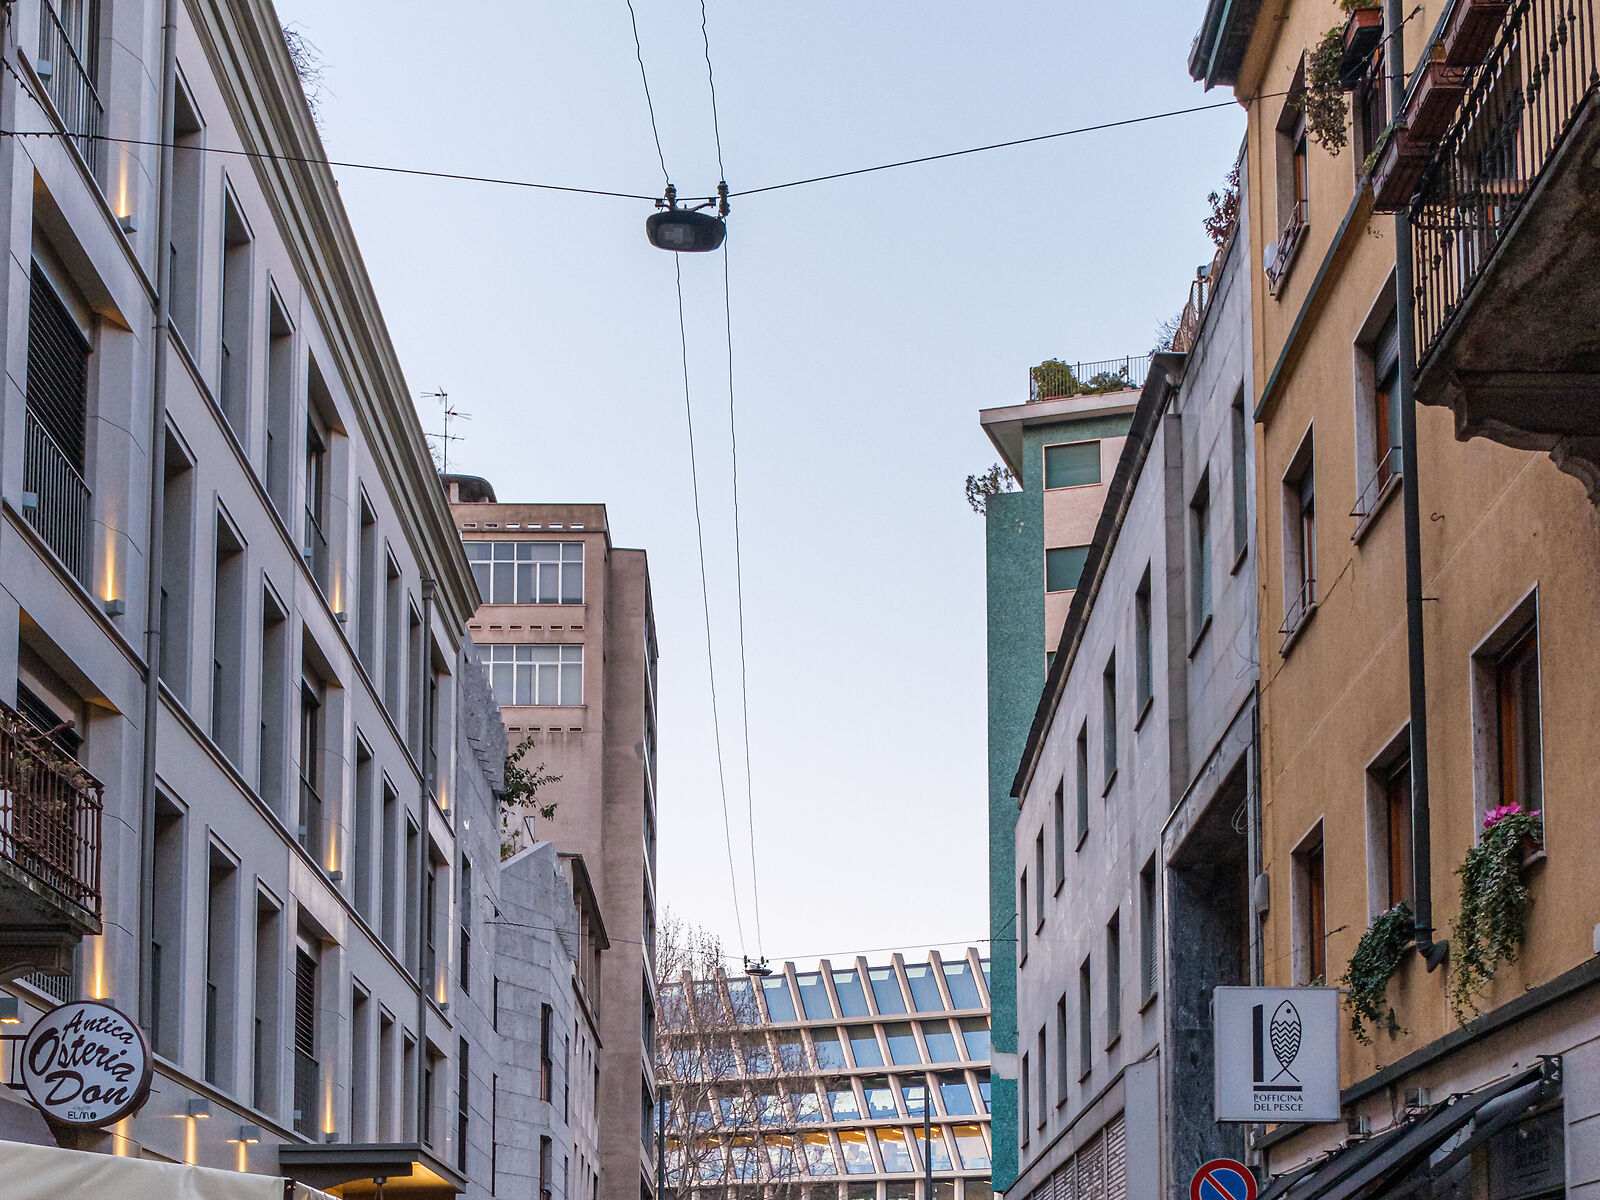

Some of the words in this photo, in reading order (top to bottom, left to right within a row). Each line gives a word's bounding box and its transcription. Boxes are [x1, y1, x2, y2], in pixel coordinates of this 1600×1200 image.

[61, 1009, 134, 1045] Antica
[28, 1026, 136, 1083] Osteria
[44, 1069, 131, 1106] Don
[1253, 1103, 1271, 1112] DEL
[1273, 1103, 1304, 1112] PESCE
